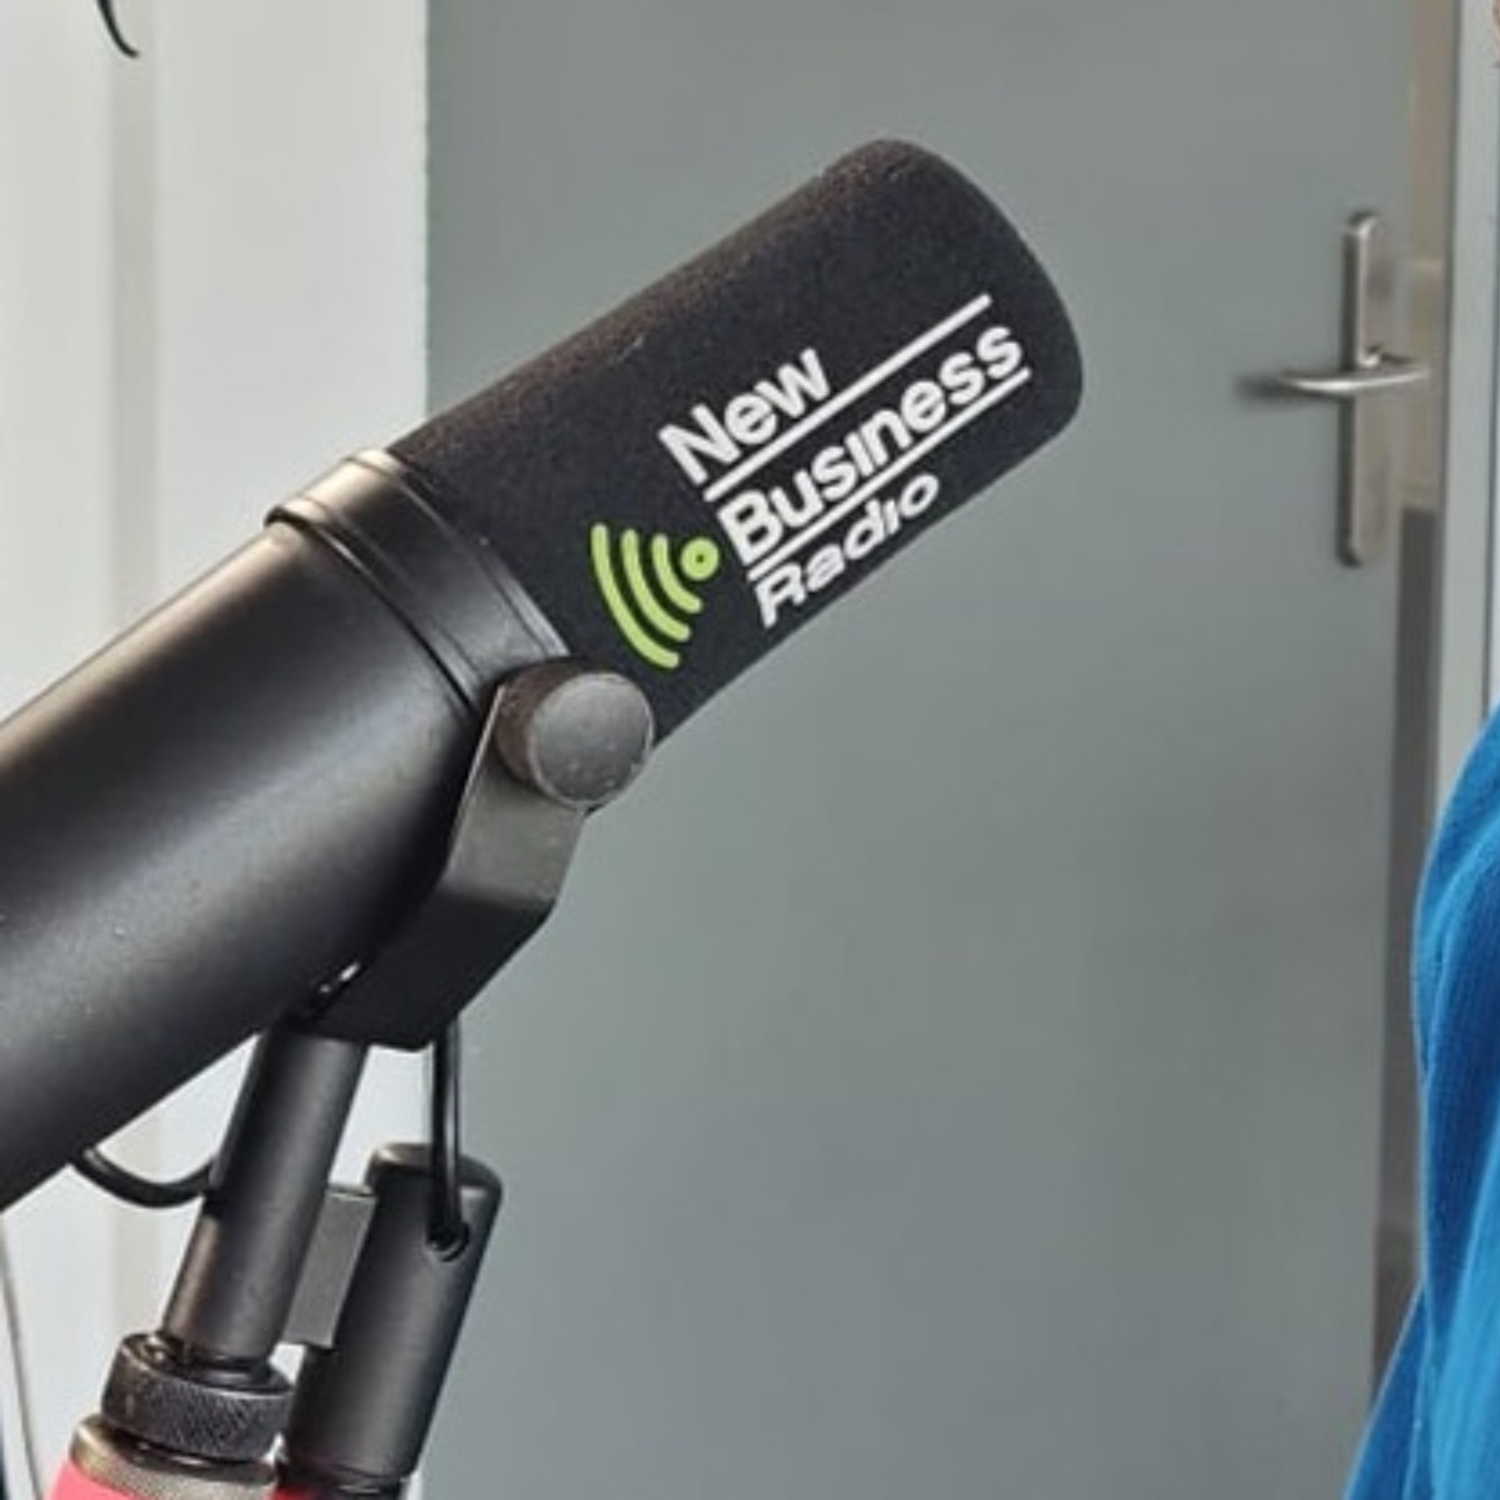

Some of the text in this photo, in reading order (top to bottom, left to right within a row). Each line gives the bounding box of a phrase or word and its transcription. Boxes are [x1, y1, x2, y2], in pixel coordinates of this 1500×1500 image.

[658, 348, 831, 487] New
[716, 326, 1024, 566] Business
[754, 473, 940, 629] Radio
